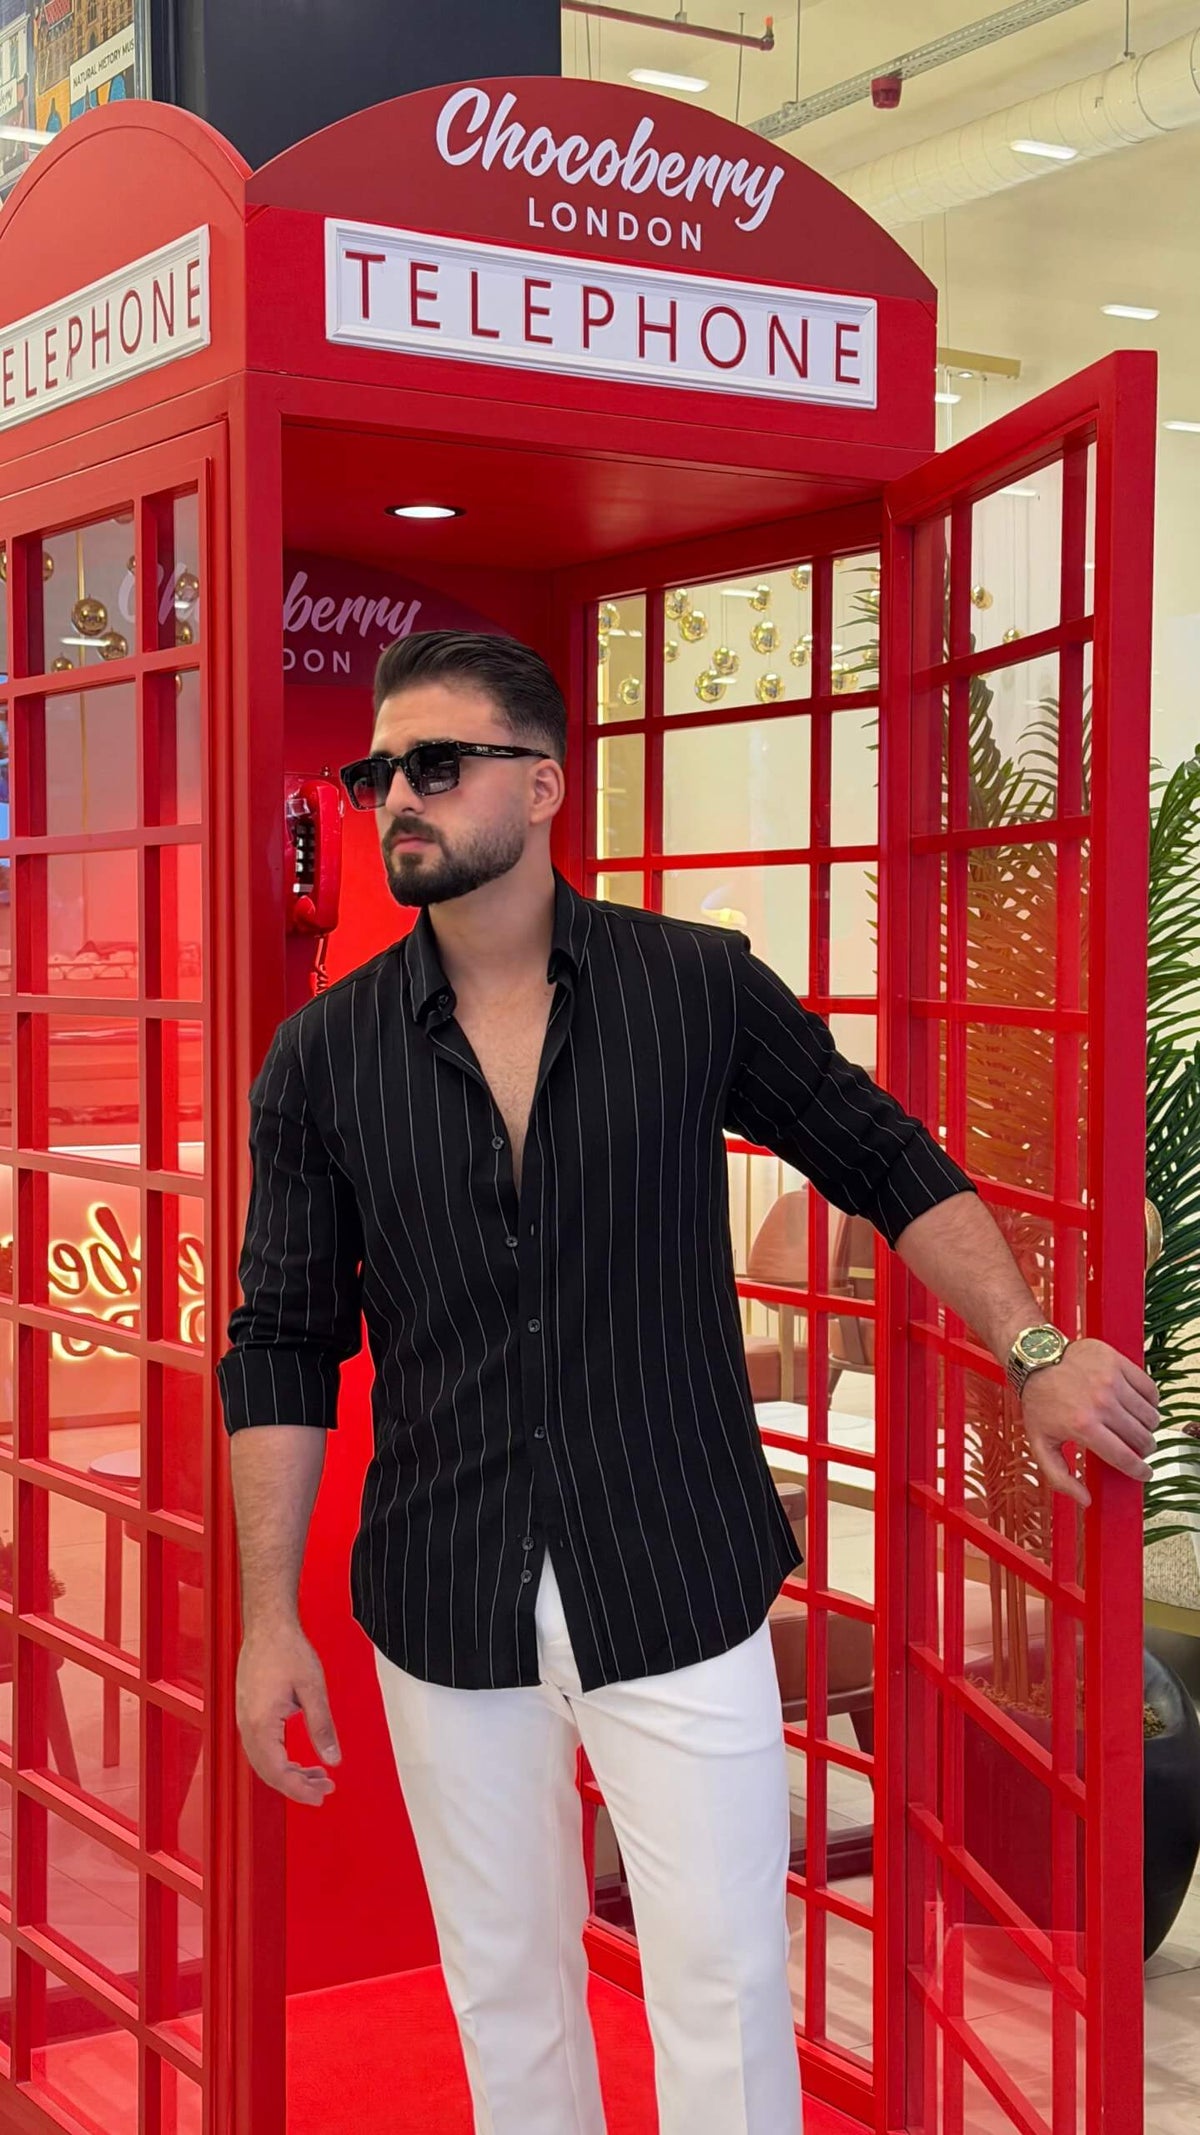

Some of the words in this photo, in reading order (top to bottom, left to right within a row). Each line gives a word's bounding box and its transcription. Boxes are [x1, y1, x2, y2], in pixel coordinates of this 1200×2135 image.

[436, 87, 785, 232] Chocoberry
[528, 197, 702, 252] LONDON
[2, 258, 200, 408] ELEPHONE
[344, 250, 861, 385] TELEPHONE
